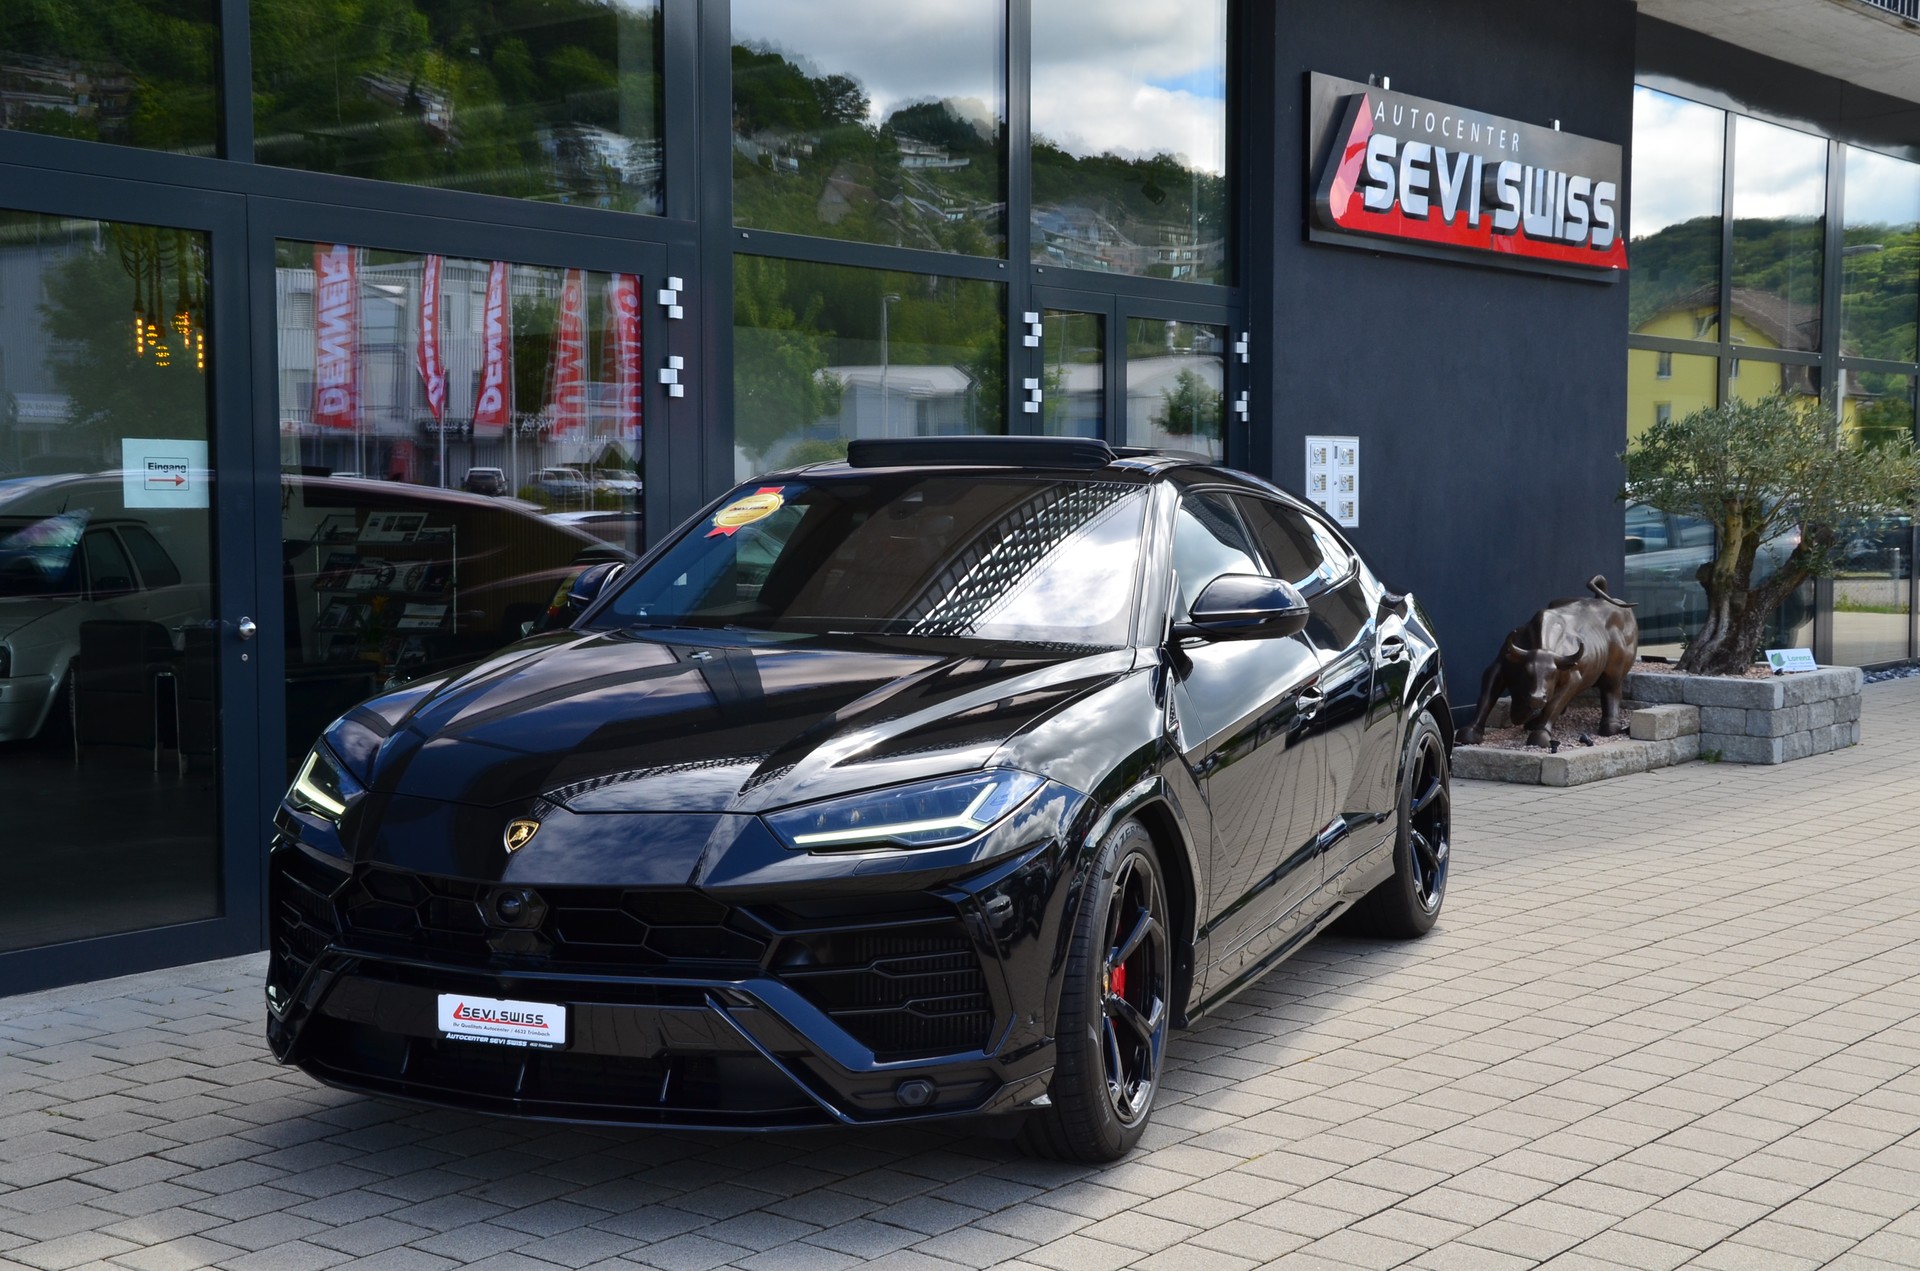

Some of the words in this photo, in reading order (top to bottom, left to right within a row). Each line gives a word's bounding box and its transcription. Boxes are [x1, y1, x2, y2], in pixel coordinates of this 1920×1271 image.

[1374, 100, 1520, 152] AUTOCENTER
[1364, 133, 1483, 225] SEVI
[1494, 160, 1617, 248] SWISS
[147, 462, 187, 473] Eingang
[462, 1007, 496, 1020] SEVI
[500, 1011, 544, 1025] SWISS
[506, 1039, 528, 1047] SWISS
